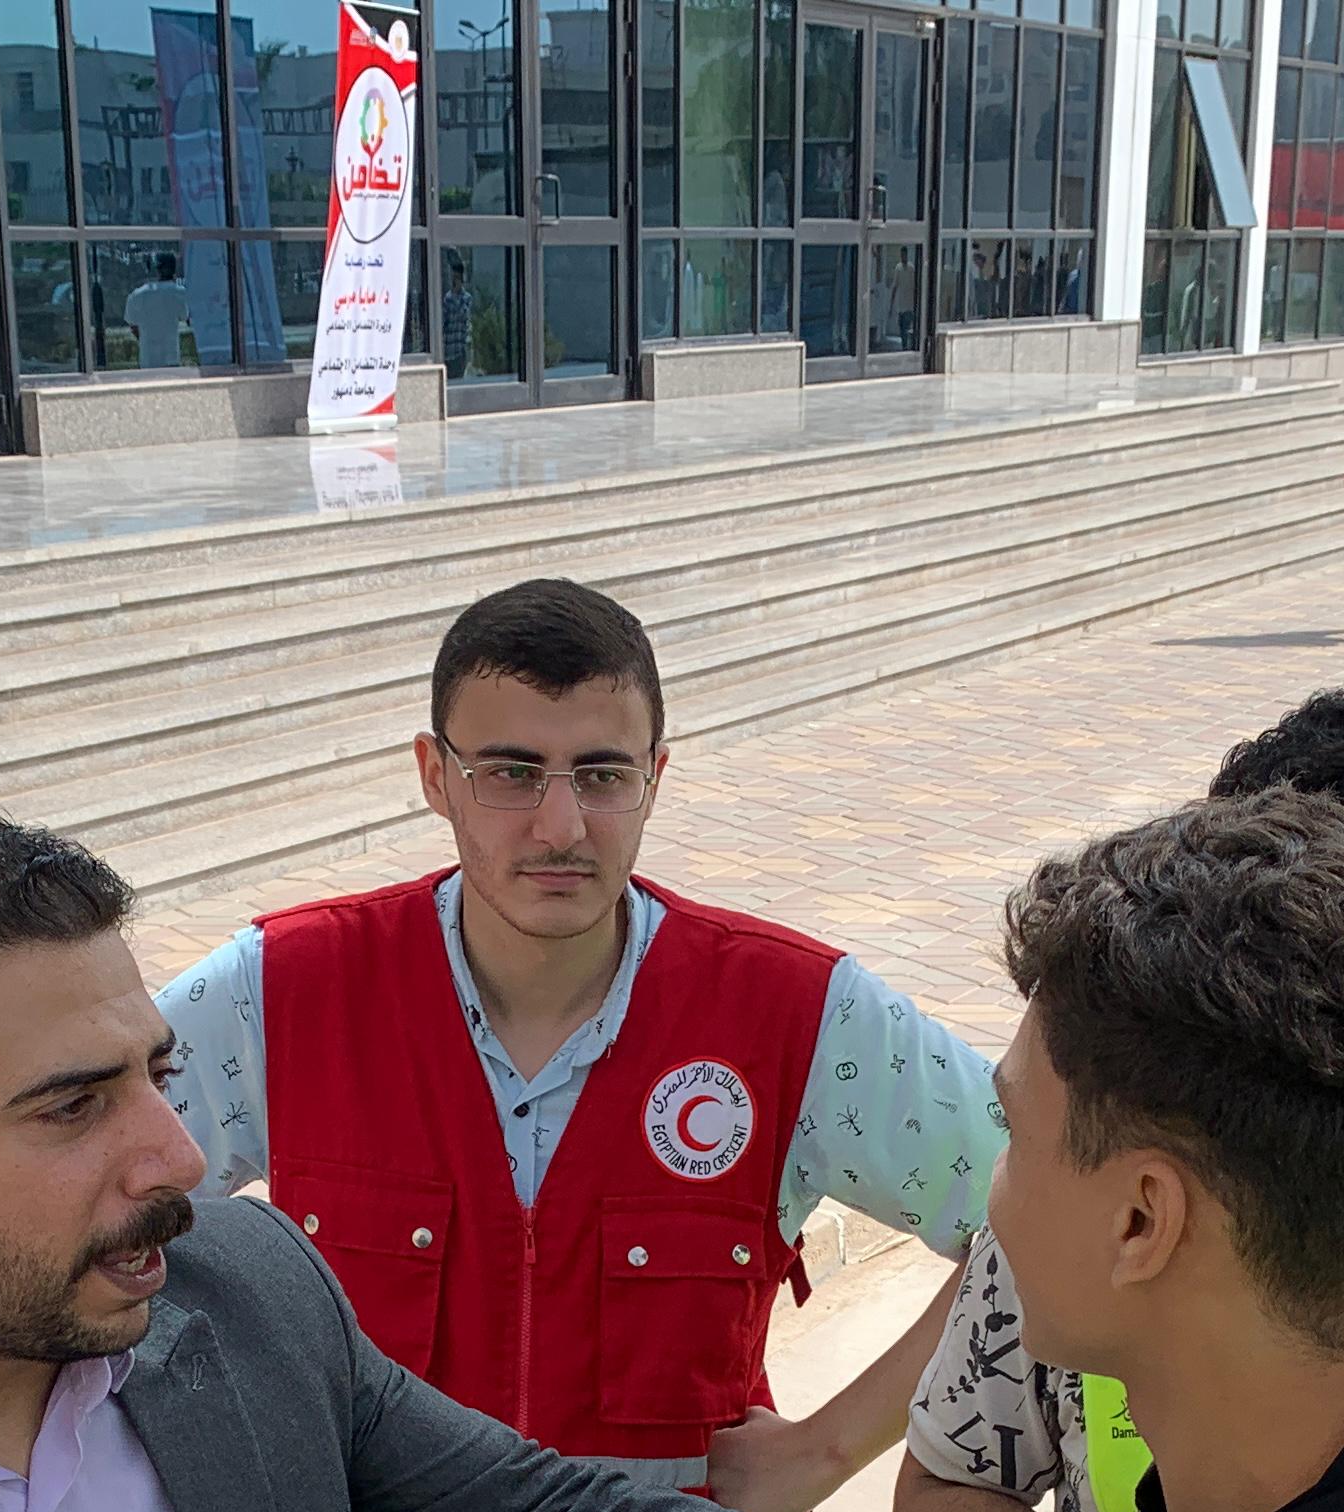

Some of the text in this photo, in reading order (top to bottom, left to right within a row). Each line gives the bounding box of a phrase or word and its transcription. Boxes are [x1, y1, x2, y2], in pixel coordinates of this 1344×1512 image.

[343, 150, 402, 201] تضامن
[652, 1123, 748, 1175] EGYPTIAN RED CRESCENT
